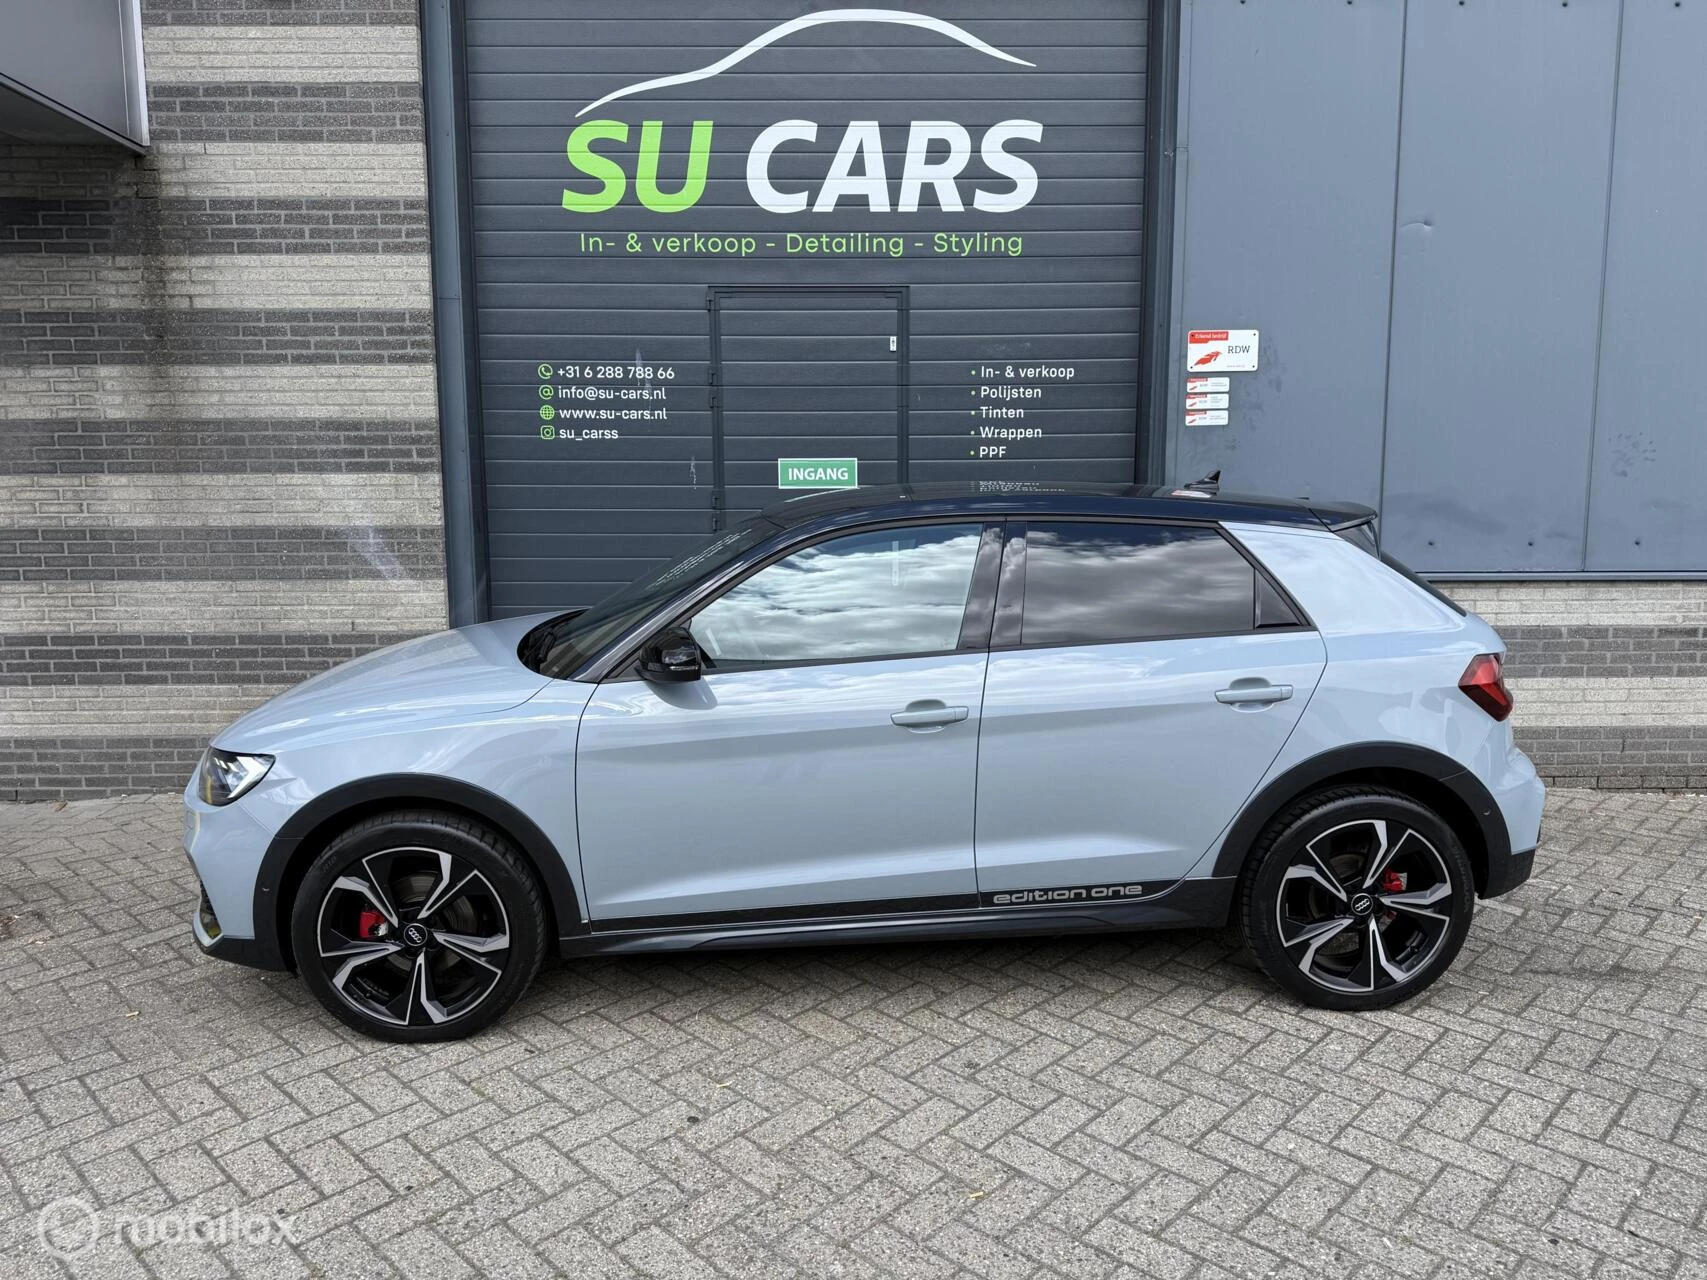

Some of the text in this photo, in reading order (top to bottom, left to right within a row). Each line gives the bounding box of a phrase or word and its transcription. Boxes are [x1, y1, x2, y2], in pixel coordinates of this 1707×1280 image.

[561, 119, 1043, 213] SU CARS
[580, 233, 616, 252] In-
[625, 233, 642, 252] &
[651, 233, 756, 257] verkoop
[786, 233, 903, 257] Detailing
[933, 233, 1023, 257] Styling
[1227, 345, 1250, 354] RDW
[557, 366, 675, 379] +31 6 288 788 66
[981, 365, 1075, 380] In- & verkoop
[558, 386, 666, 400] info@su-cars.nl
[980, 386, 1042, 401] Polijsten
[559, 407, 667, 420] www.su-cars.nl
[980, 406, 1024, 418] Tinten
[559, 428, 619, 441] su_carss
[980, 426, 1042, 440] Wrappen
[979, 446, 1007, 458] PPF
[788, 467, 849, 480] INGANG
[993, 885, 1143, 904] edition one
